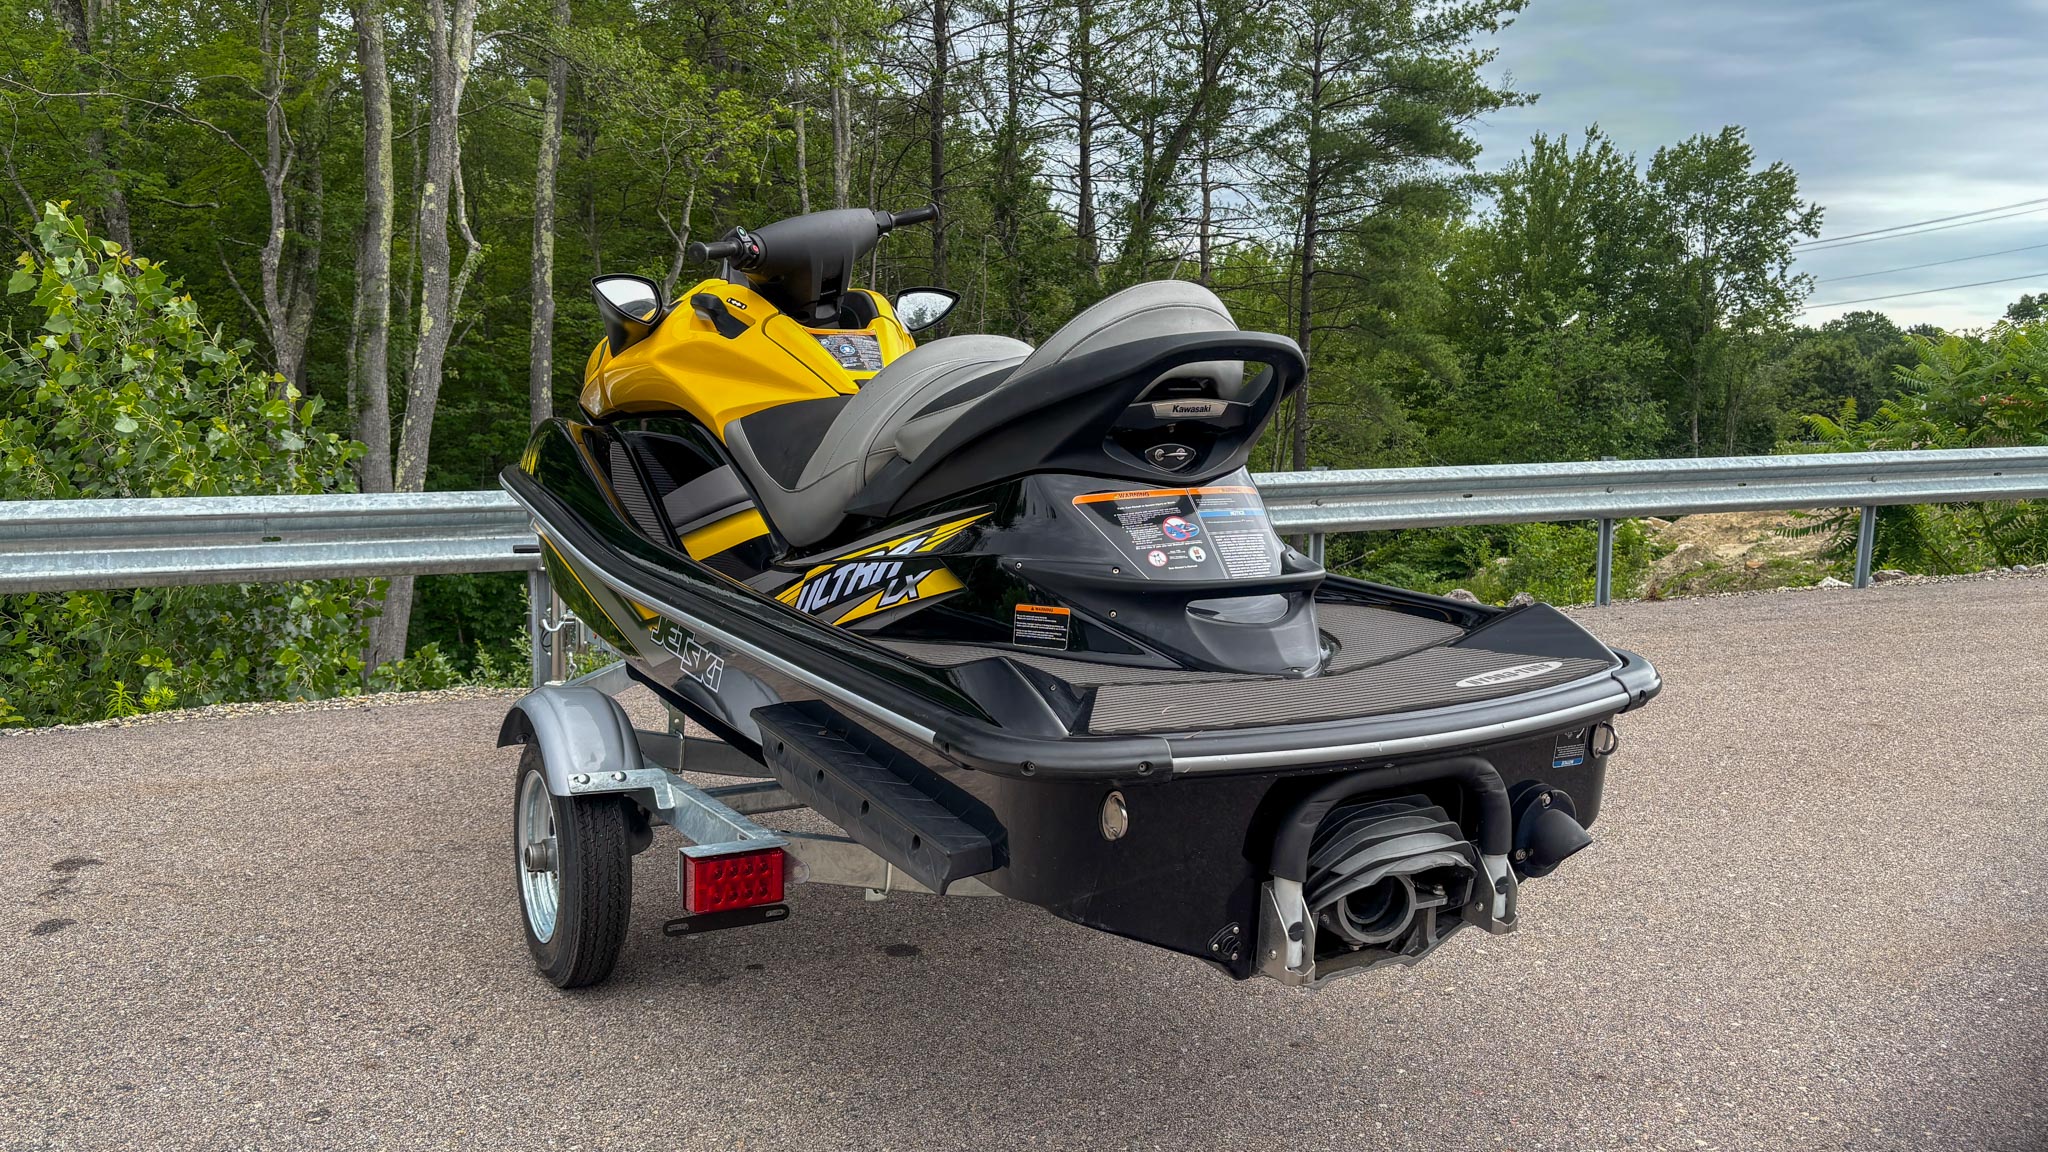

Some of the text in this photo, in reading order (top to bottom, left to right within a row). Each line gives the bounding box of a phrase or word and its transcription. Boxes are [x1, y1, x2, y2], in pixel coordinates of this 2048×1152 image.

[1172, 404, 1212, 413] Kawasaki
[795, 536, 928, 614] ULTRA
[876, 569, 933, 608] LX
